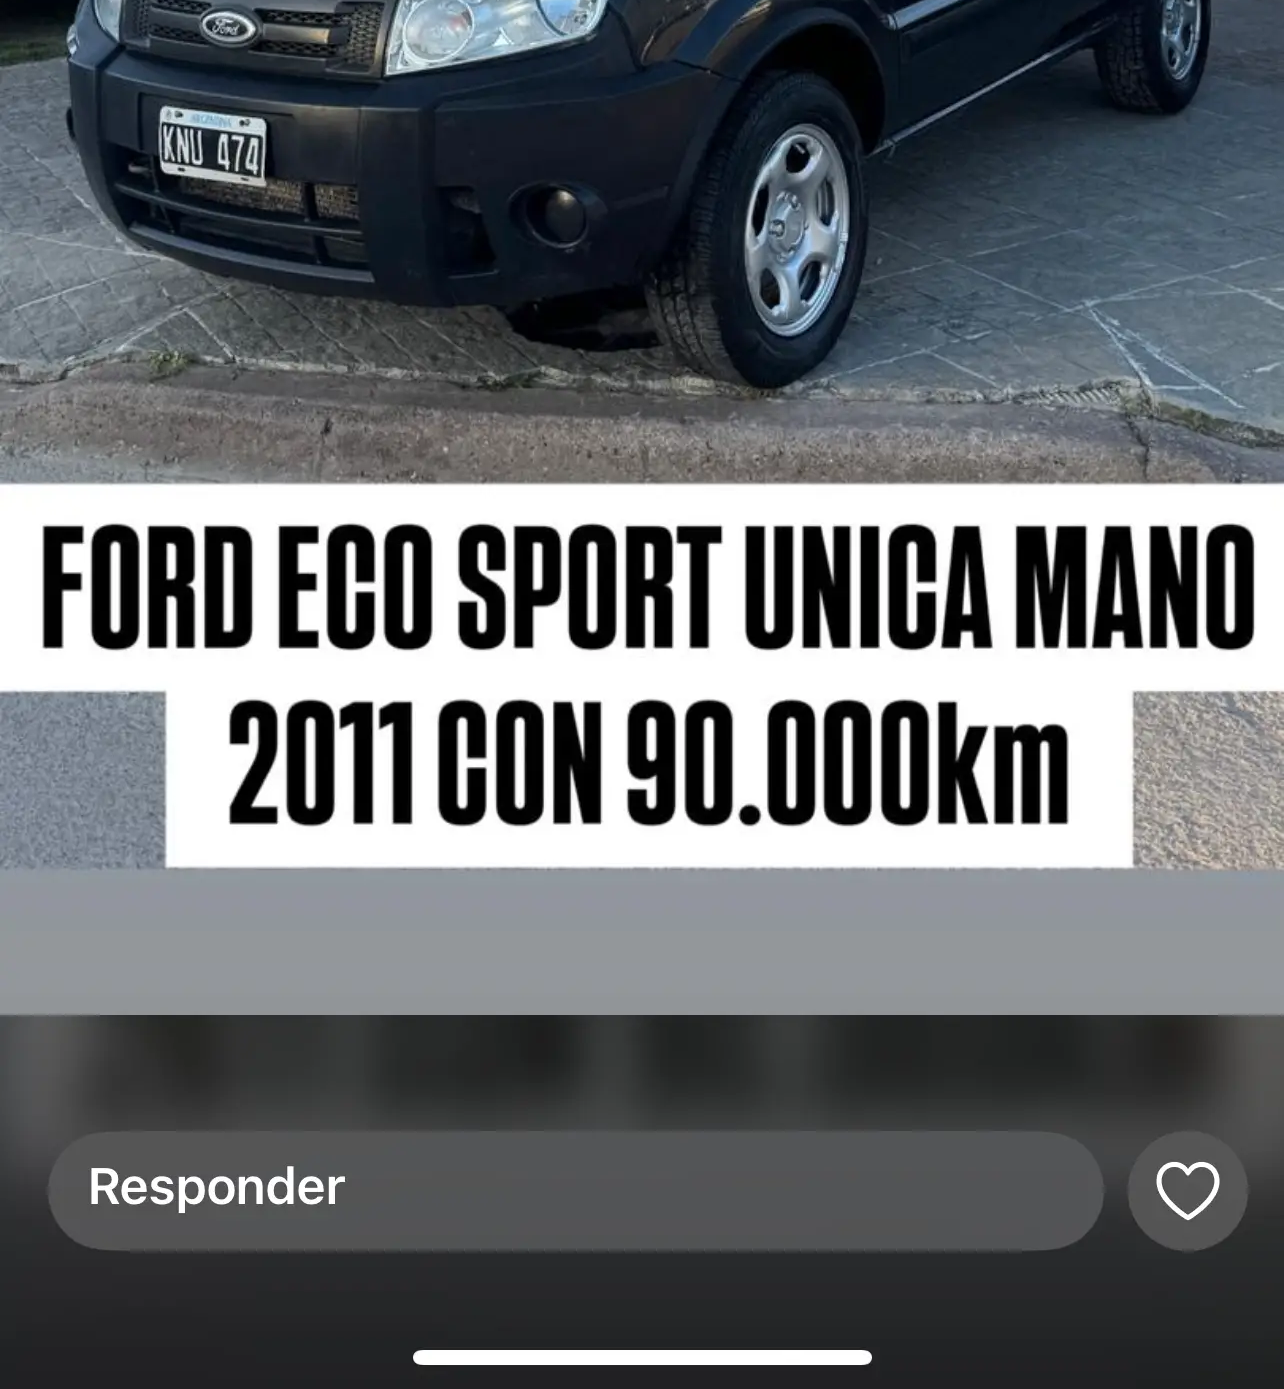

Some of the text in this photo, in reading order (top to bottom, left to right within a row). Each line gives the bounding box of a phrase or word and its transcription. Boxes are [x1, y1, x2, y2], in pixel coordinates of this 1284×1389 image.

[212, 18, 240, 36] Ford
[162, 124, 260, 175] KNU 474
